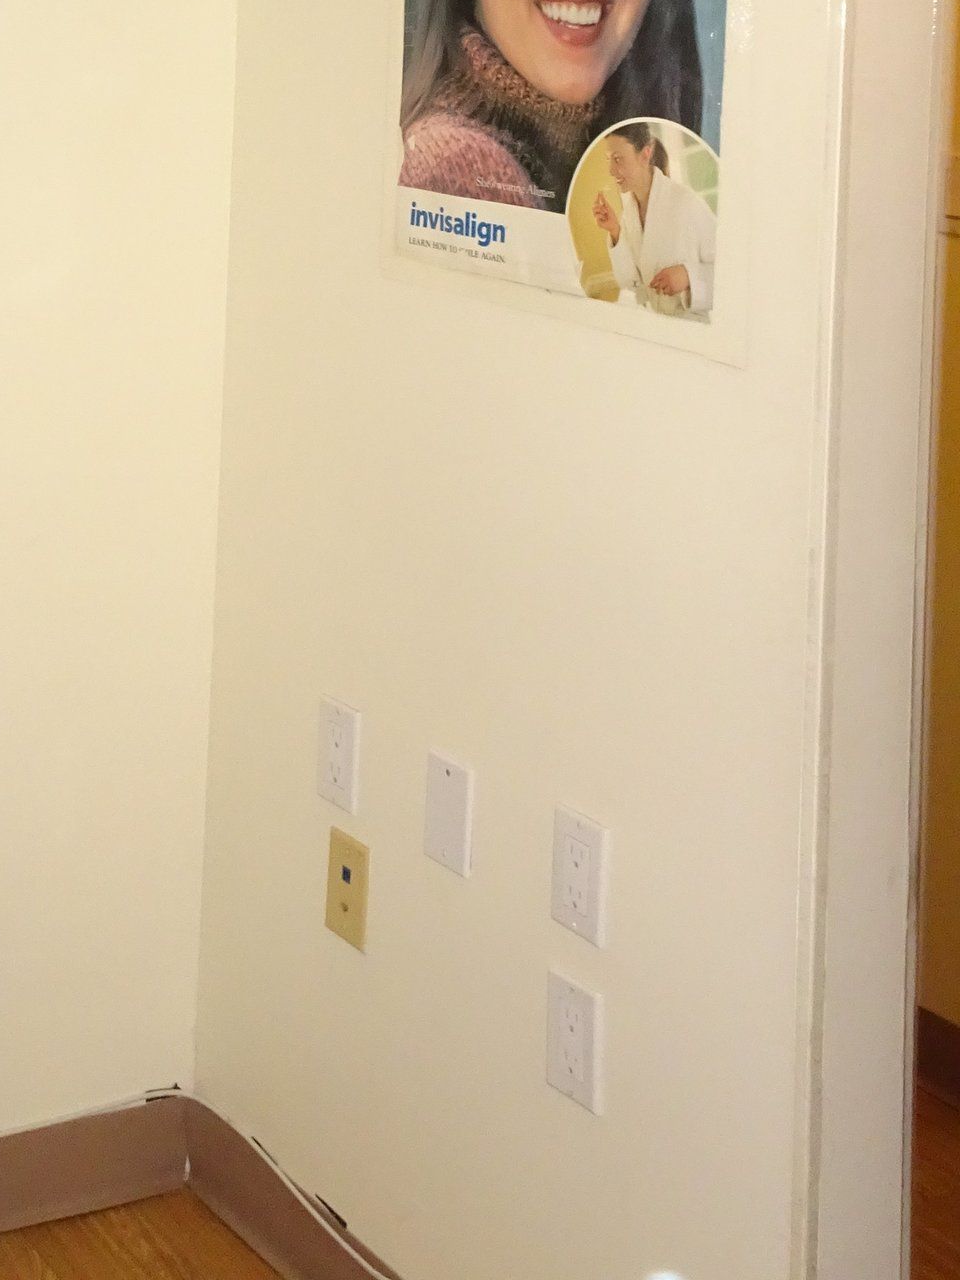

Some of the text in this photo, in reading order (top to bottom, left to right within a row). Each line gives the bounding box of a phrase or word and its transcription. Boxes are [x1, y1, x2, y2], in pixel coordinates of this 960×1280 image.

[410, 201, 506, 247] invisalign
[408, 237, 431, 248] LEARN
[432, 241, 447, 251] HOW
[449, 244, 458, 254] TO
